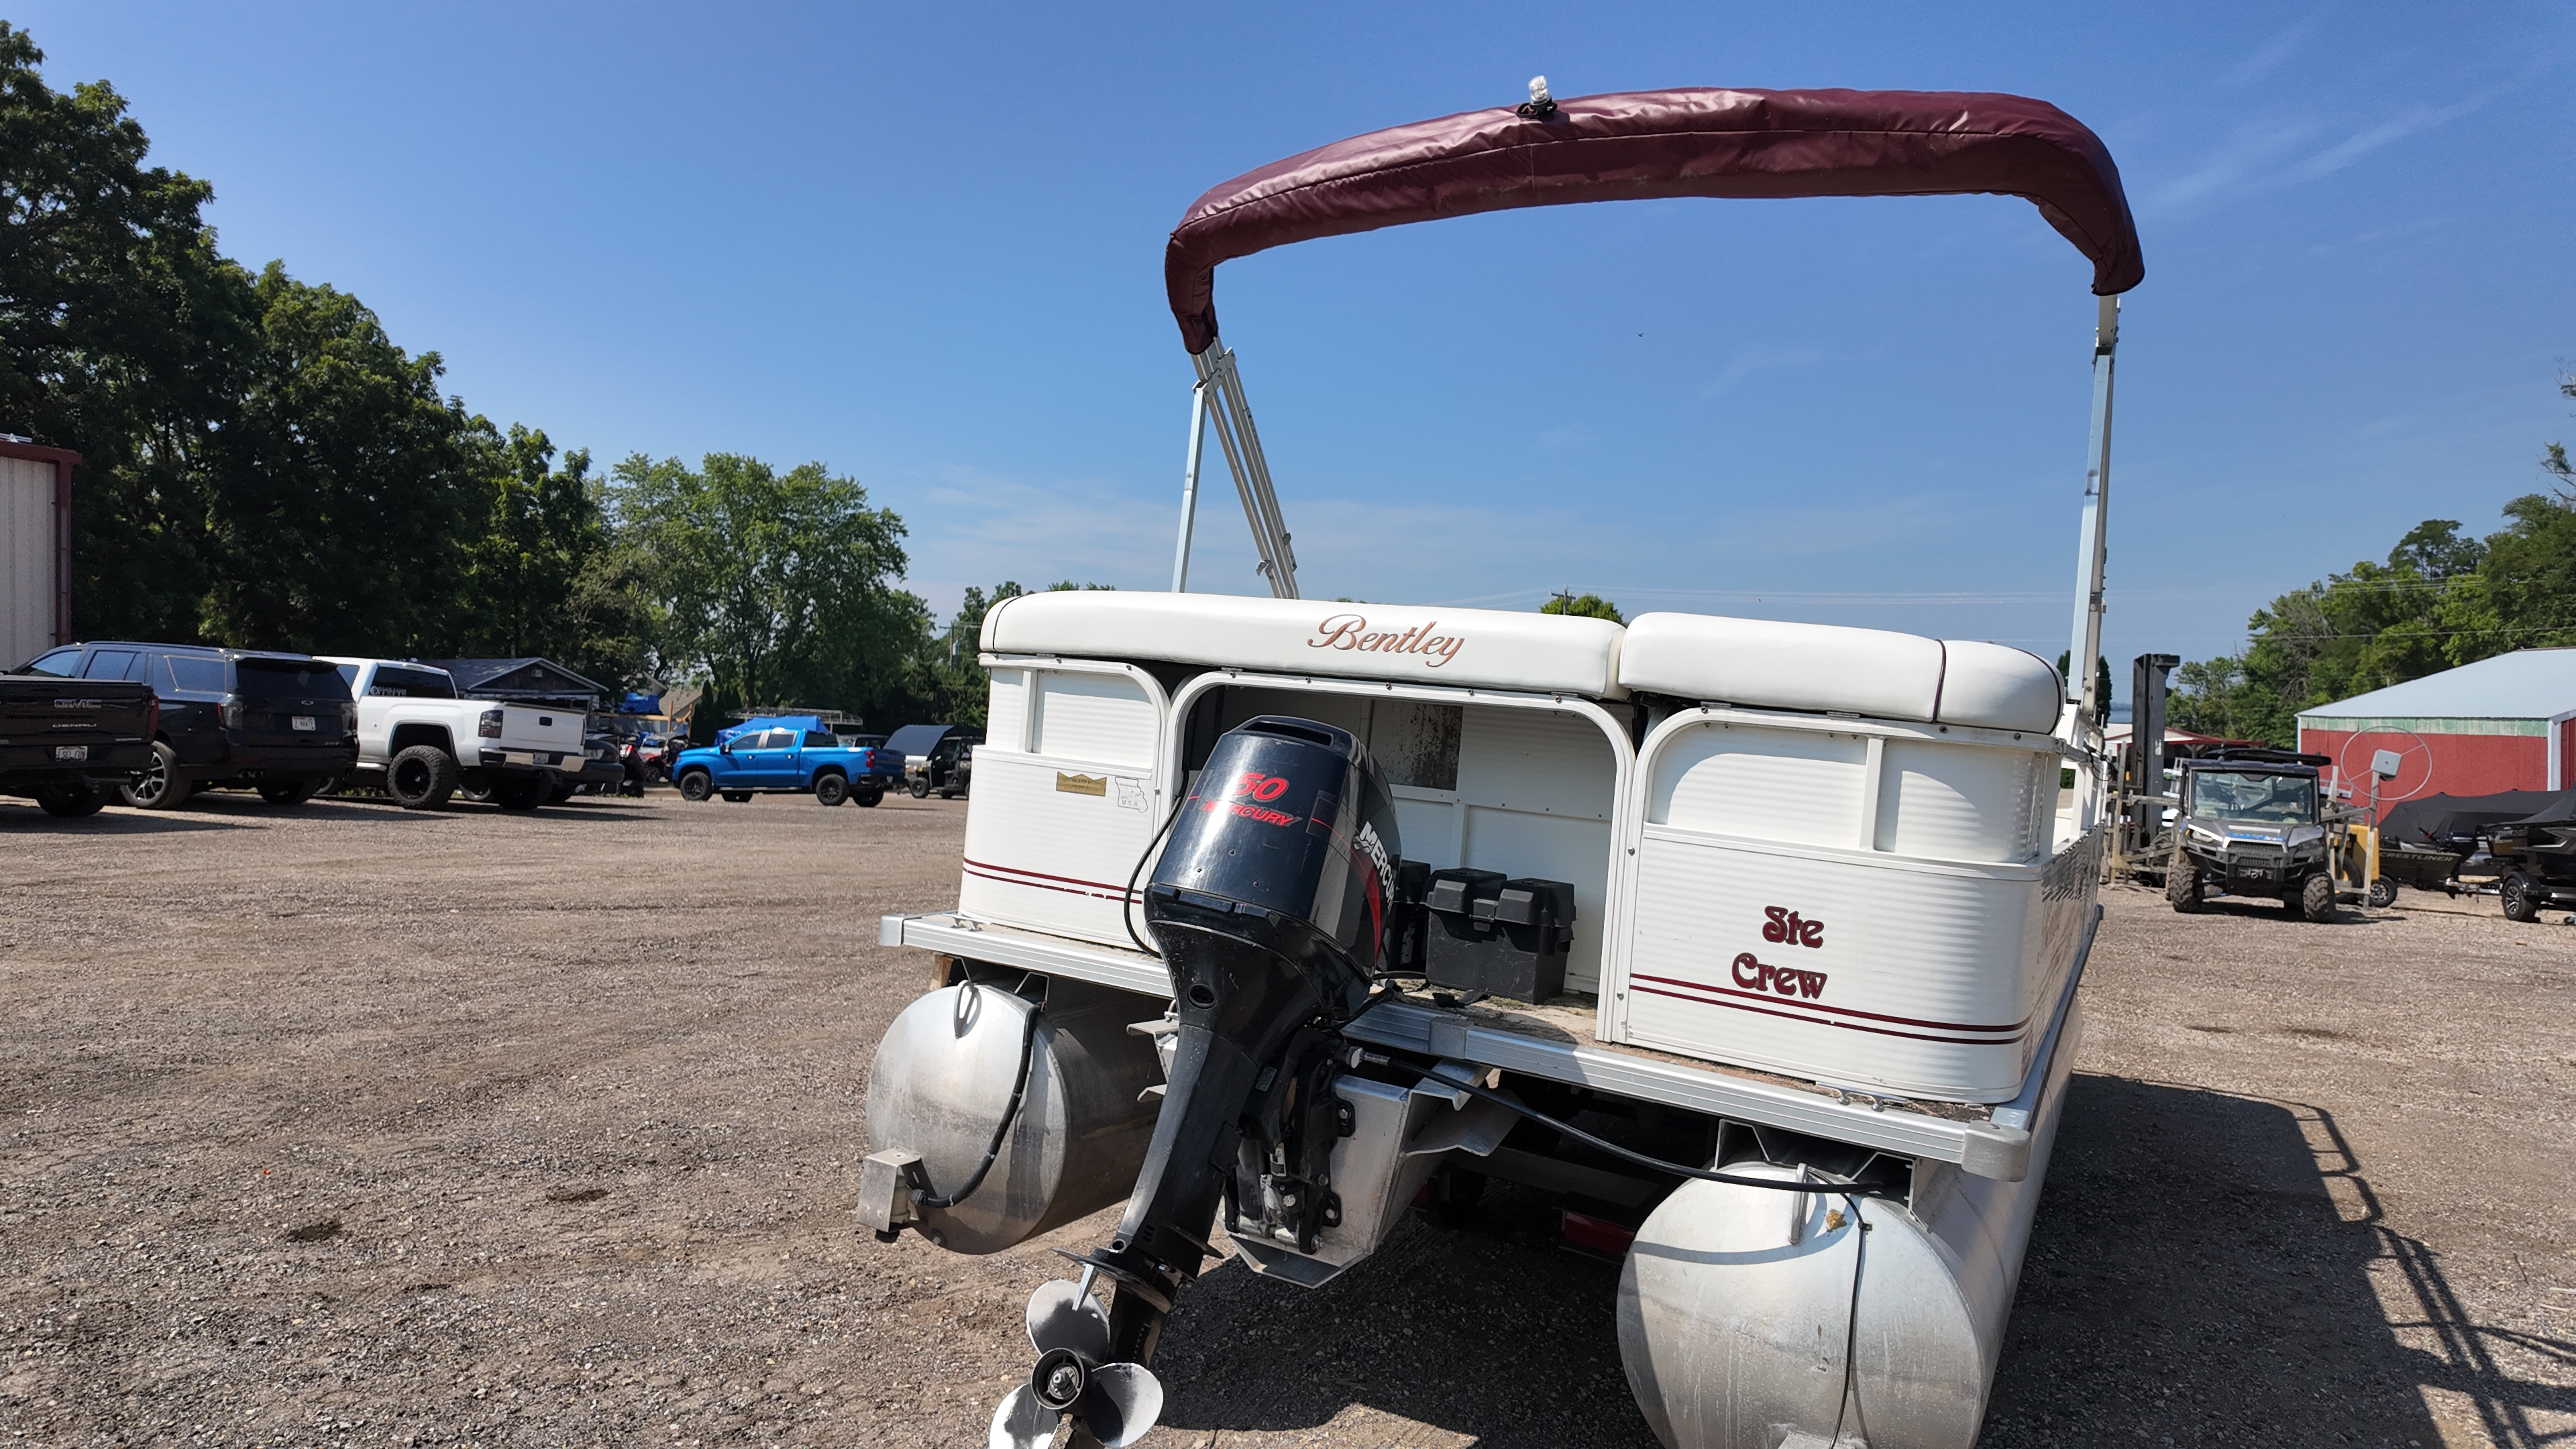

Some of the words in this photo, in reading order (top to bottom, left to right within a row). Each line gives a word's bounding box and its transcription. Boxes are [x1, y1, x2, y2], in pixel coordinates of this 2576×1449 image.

[1307, 614, 1465, 667] Bentley
[54, 699, 101, 708] GMC
[1232, 771, 1289, 802] 50
[1202, 800, 1294, 826] MRCURY
[2379, 851, 2453, 862] CRESTLINER
[1762, 906, 1824, 949] Ste
[1732, 953, 1827, 999] Crew
